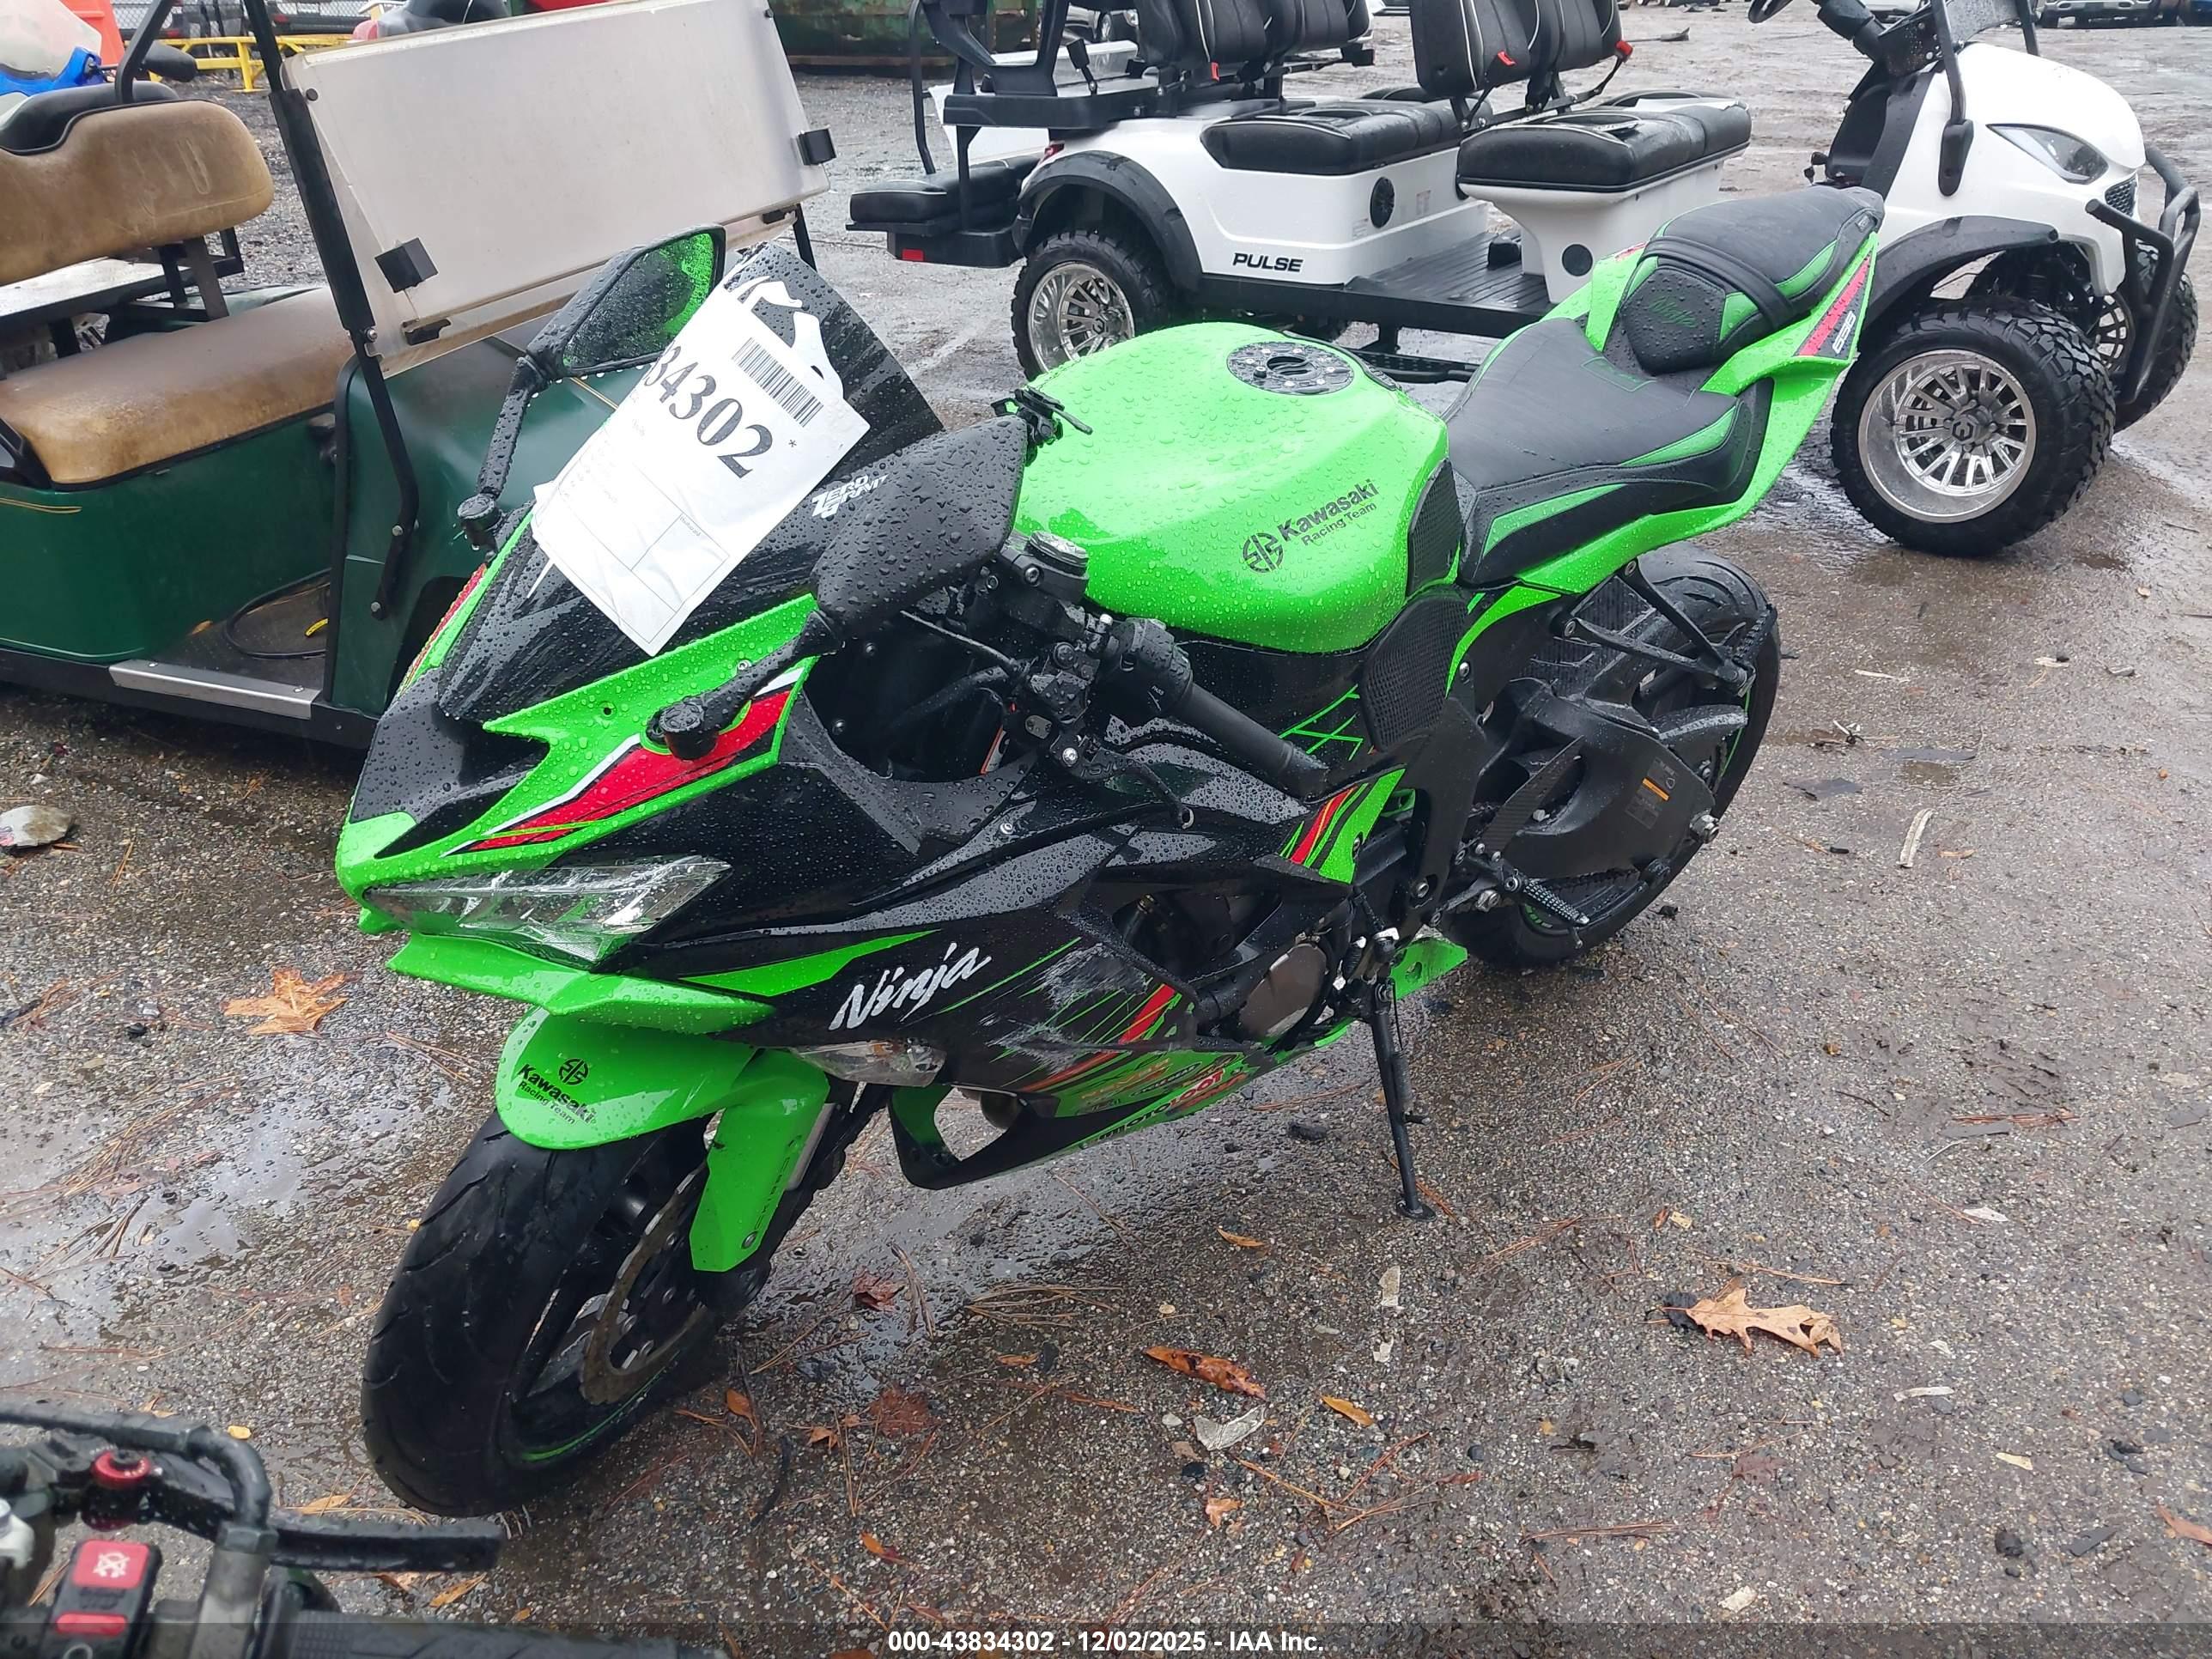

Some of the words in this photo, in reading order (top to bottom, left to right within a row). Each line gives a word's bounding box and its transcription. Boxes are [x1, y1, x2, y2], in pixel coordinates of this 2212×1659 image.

[1233, 252, 1304, 272] PULSE
[1832, 310, 1856, 354] 636
[811, 475, 869, 517] ZERO
[1278, 479, 1380, 542] Kawasaki
[1301, 519, 1346, 545] Racing
[1345, 502, 1377, 522] Team
[828, 943, 992, 1031] Ninja
[517, 1063, 594, 1123] Kawasaki
[518, 1081, 550, 1106] Racing
[550, 1101, 576, 1124] Team
